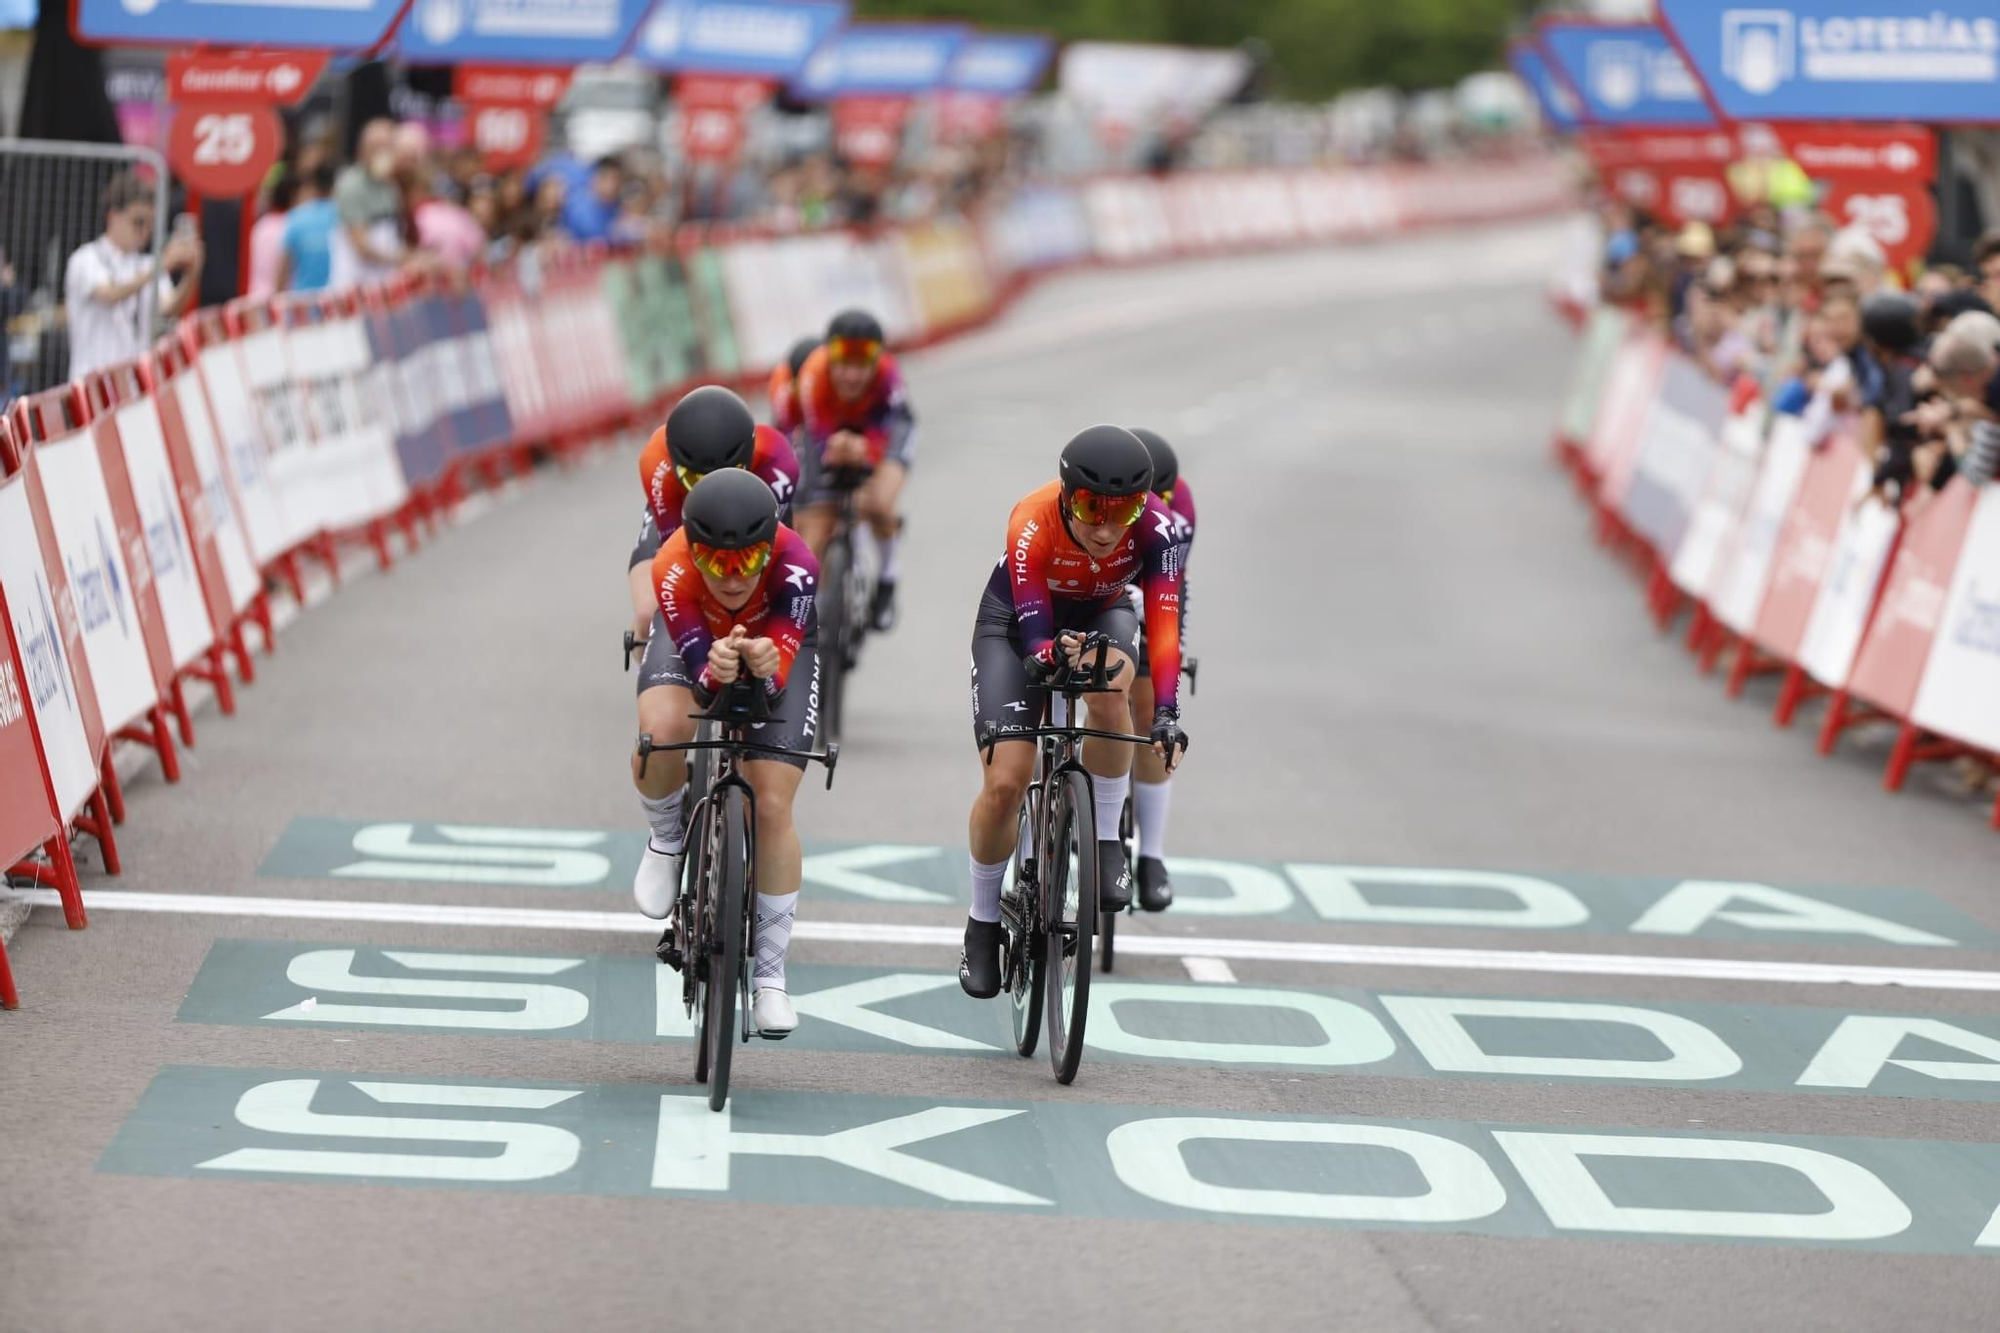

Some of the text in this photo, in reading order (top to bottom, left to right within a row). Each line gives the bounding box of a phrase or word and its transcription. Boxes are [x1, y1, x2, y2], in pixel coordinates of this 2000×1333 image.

[1800, 10, 1999, 49] LOTERÍAS
[193, 114, 254, 165] 25
[1844, 194, 1909, 245] 25
[652, 460, 671, 516] THORNE
[1015, 519, 1039, 585] THORNE
[1107, 555, 1133, 568] wahoo
[660, 562, 685, 621] THORNE
[803, 653, 821, 738] THORNE
[194, 1078, 2000, 1247] SKOD
